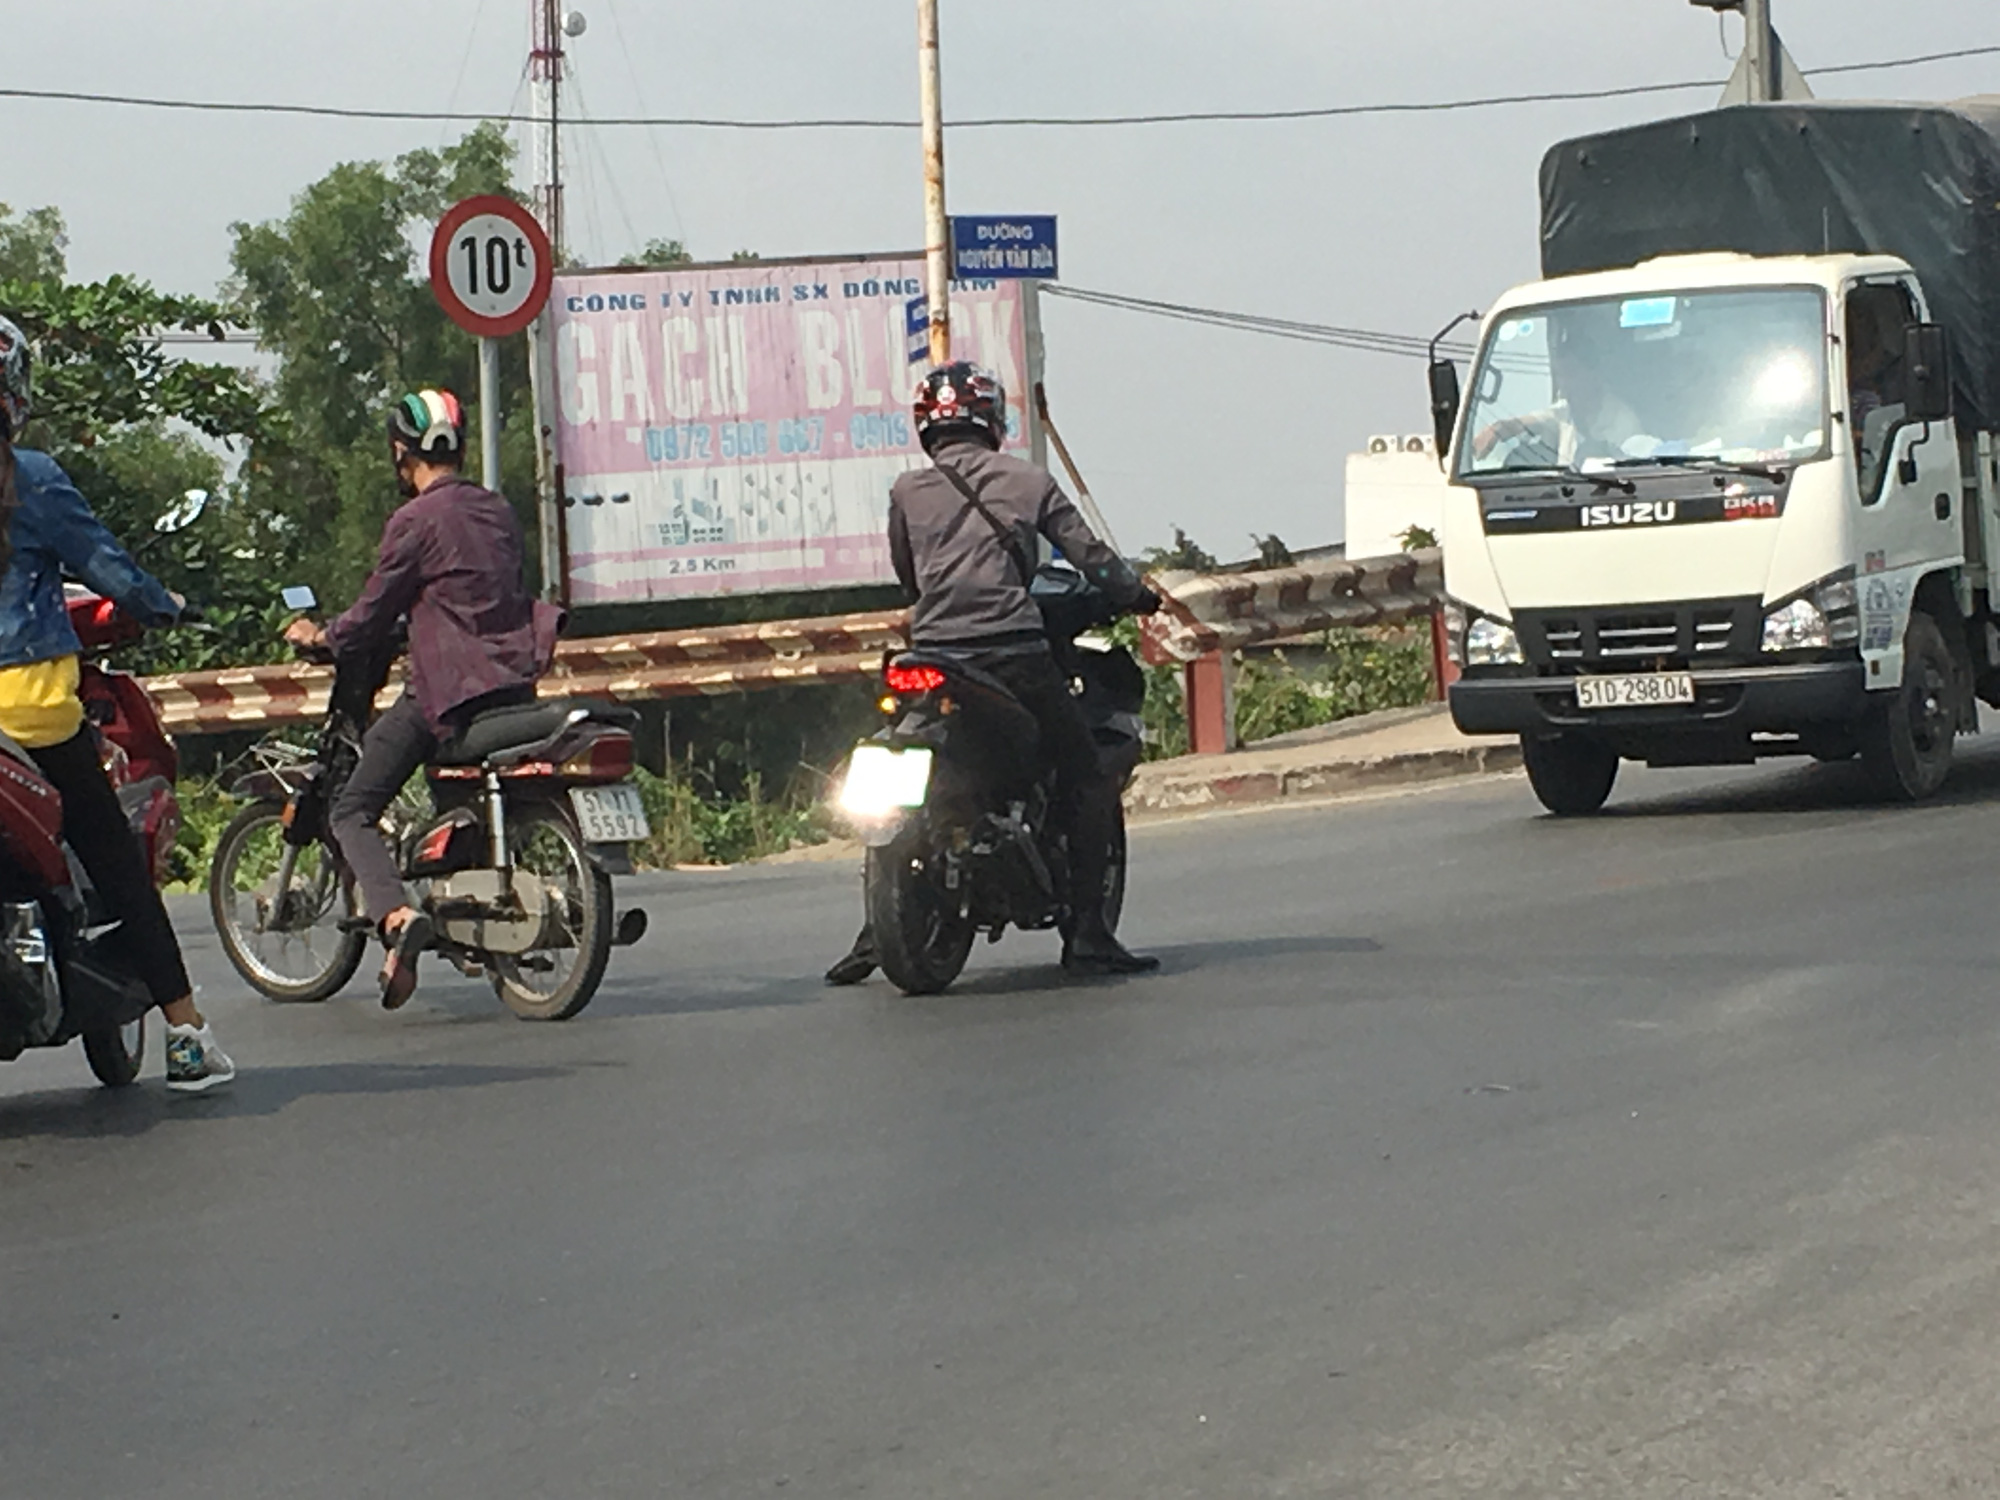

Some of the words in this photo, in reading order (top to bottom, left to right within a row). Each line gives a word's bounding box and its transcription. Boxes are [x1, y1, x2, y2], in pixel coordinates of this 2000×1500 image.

[661, 290, 693, 308] TY
[708, 286, 780, 306] TNHH
[793, 284, 829, 301] SX
[1581, 501, 1676, 527] ISUZU
[590, 814, 641, 838] 5592
